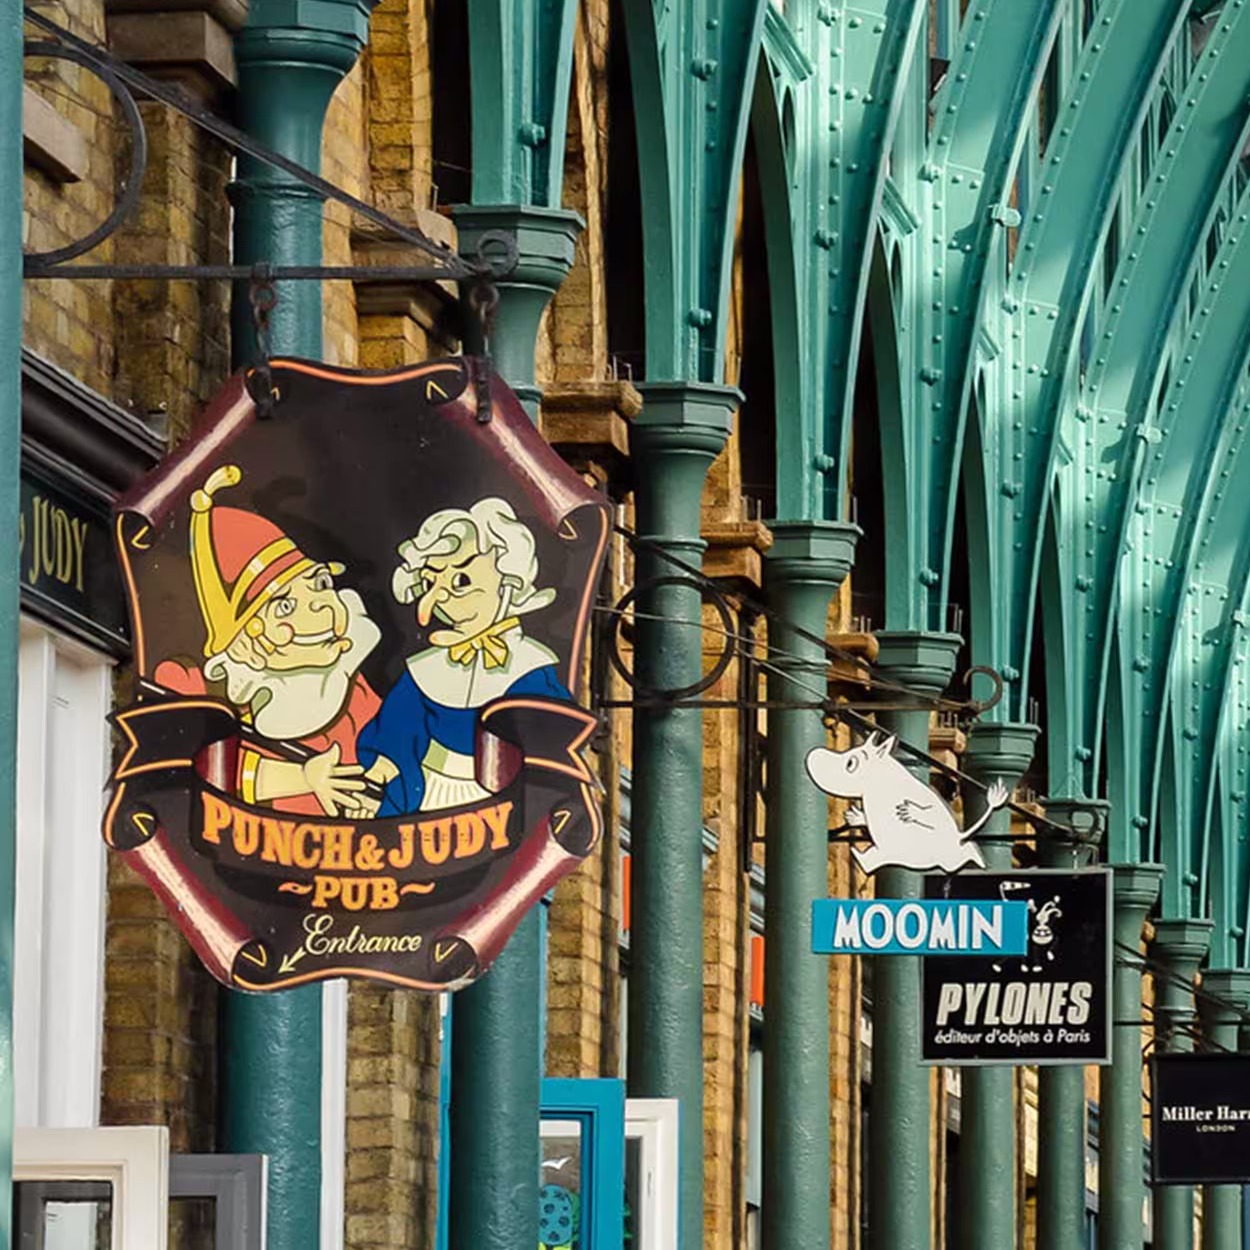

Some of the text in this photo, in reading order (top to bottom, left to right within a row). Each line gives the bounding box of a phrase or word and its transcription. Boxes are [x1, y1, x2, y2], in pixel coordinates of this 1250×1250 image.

[29, 495, 88, 592] JUDY
[303, 913, 423, 956] Entrance
[833, 903, 1003, 949] MOOMIN
[935, 981, 1093, 1026] PYLONES
[934, 1027, 1091, 1047] éditeur d'objets à Paris
[1162, 1106, 1214, 1121] Miller
[1196, 1124, 1236, 1132] LONDON
